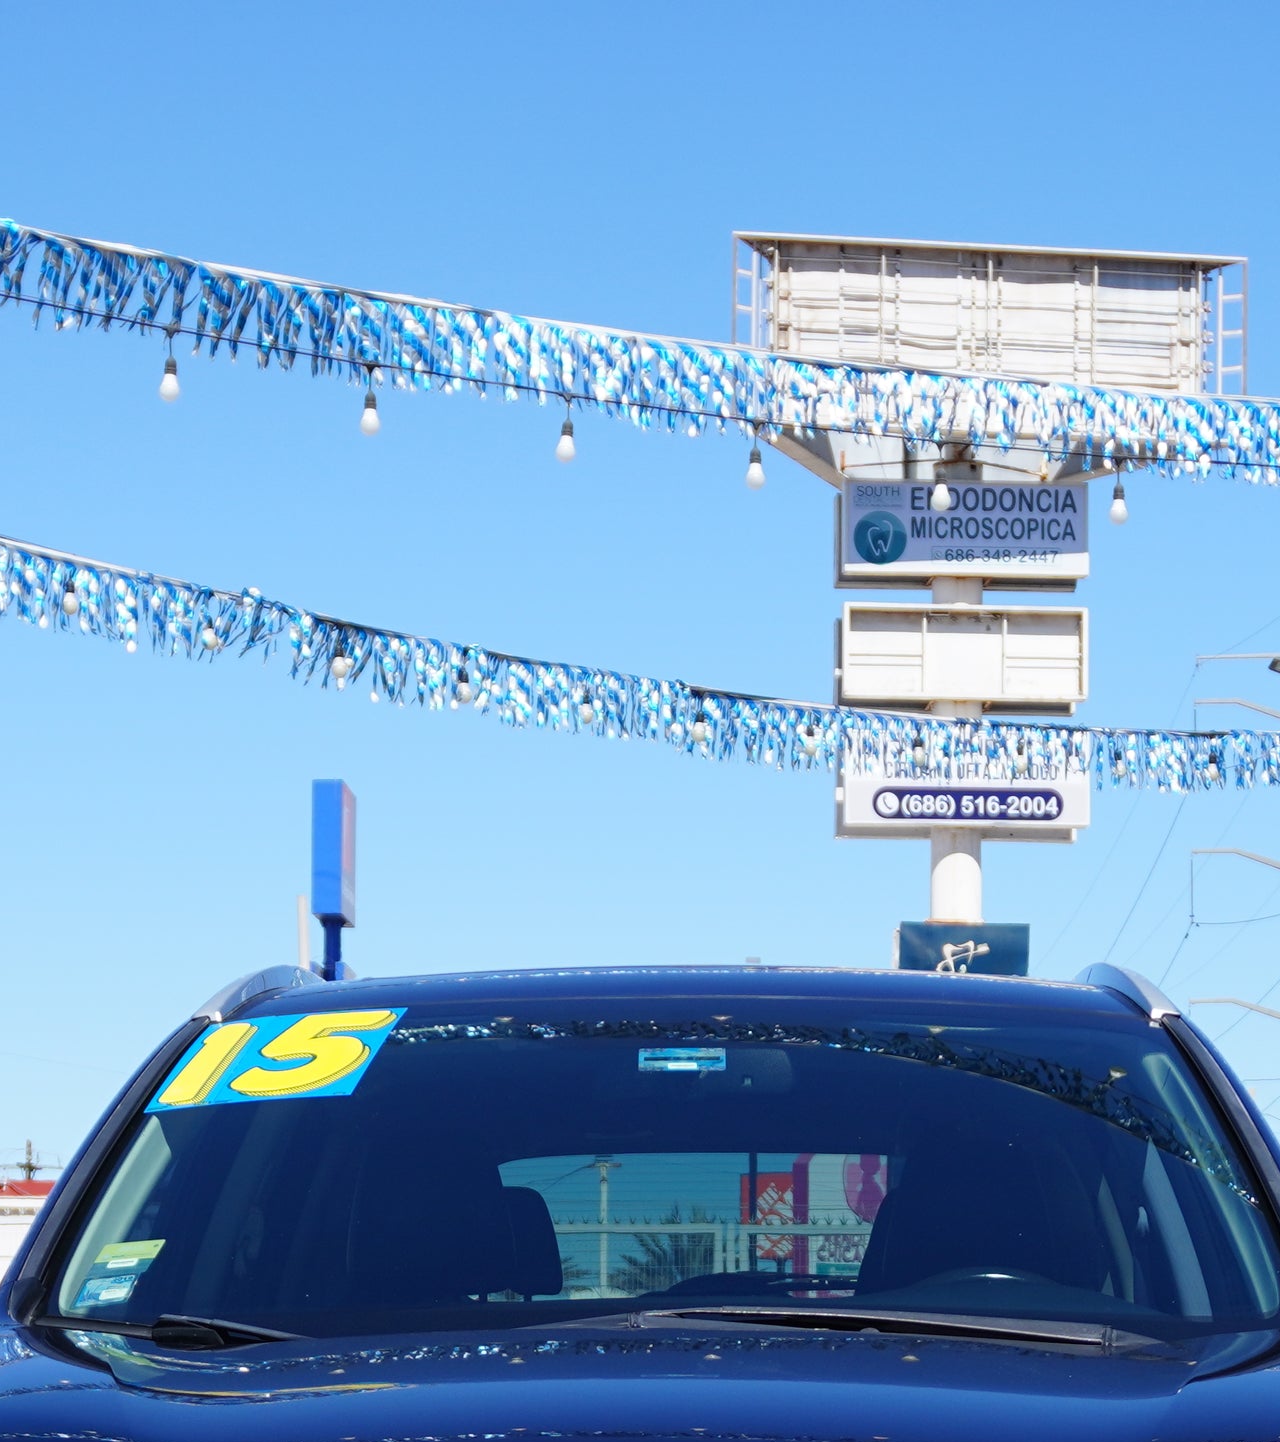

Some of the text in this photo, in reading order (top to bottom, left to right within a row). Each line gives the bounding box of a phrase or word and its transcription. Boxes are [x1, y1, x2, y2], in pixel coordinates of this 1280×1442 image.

[856, 485, 900, 497] SOUTH
[910, 516, 1077, 541] MICROSCOPICA
[944, 548, 1059, 563] 686-348-2447
[901, 794, 1059, 817] (686) 516-2004
[157, 1009, 398, 1106] 15
